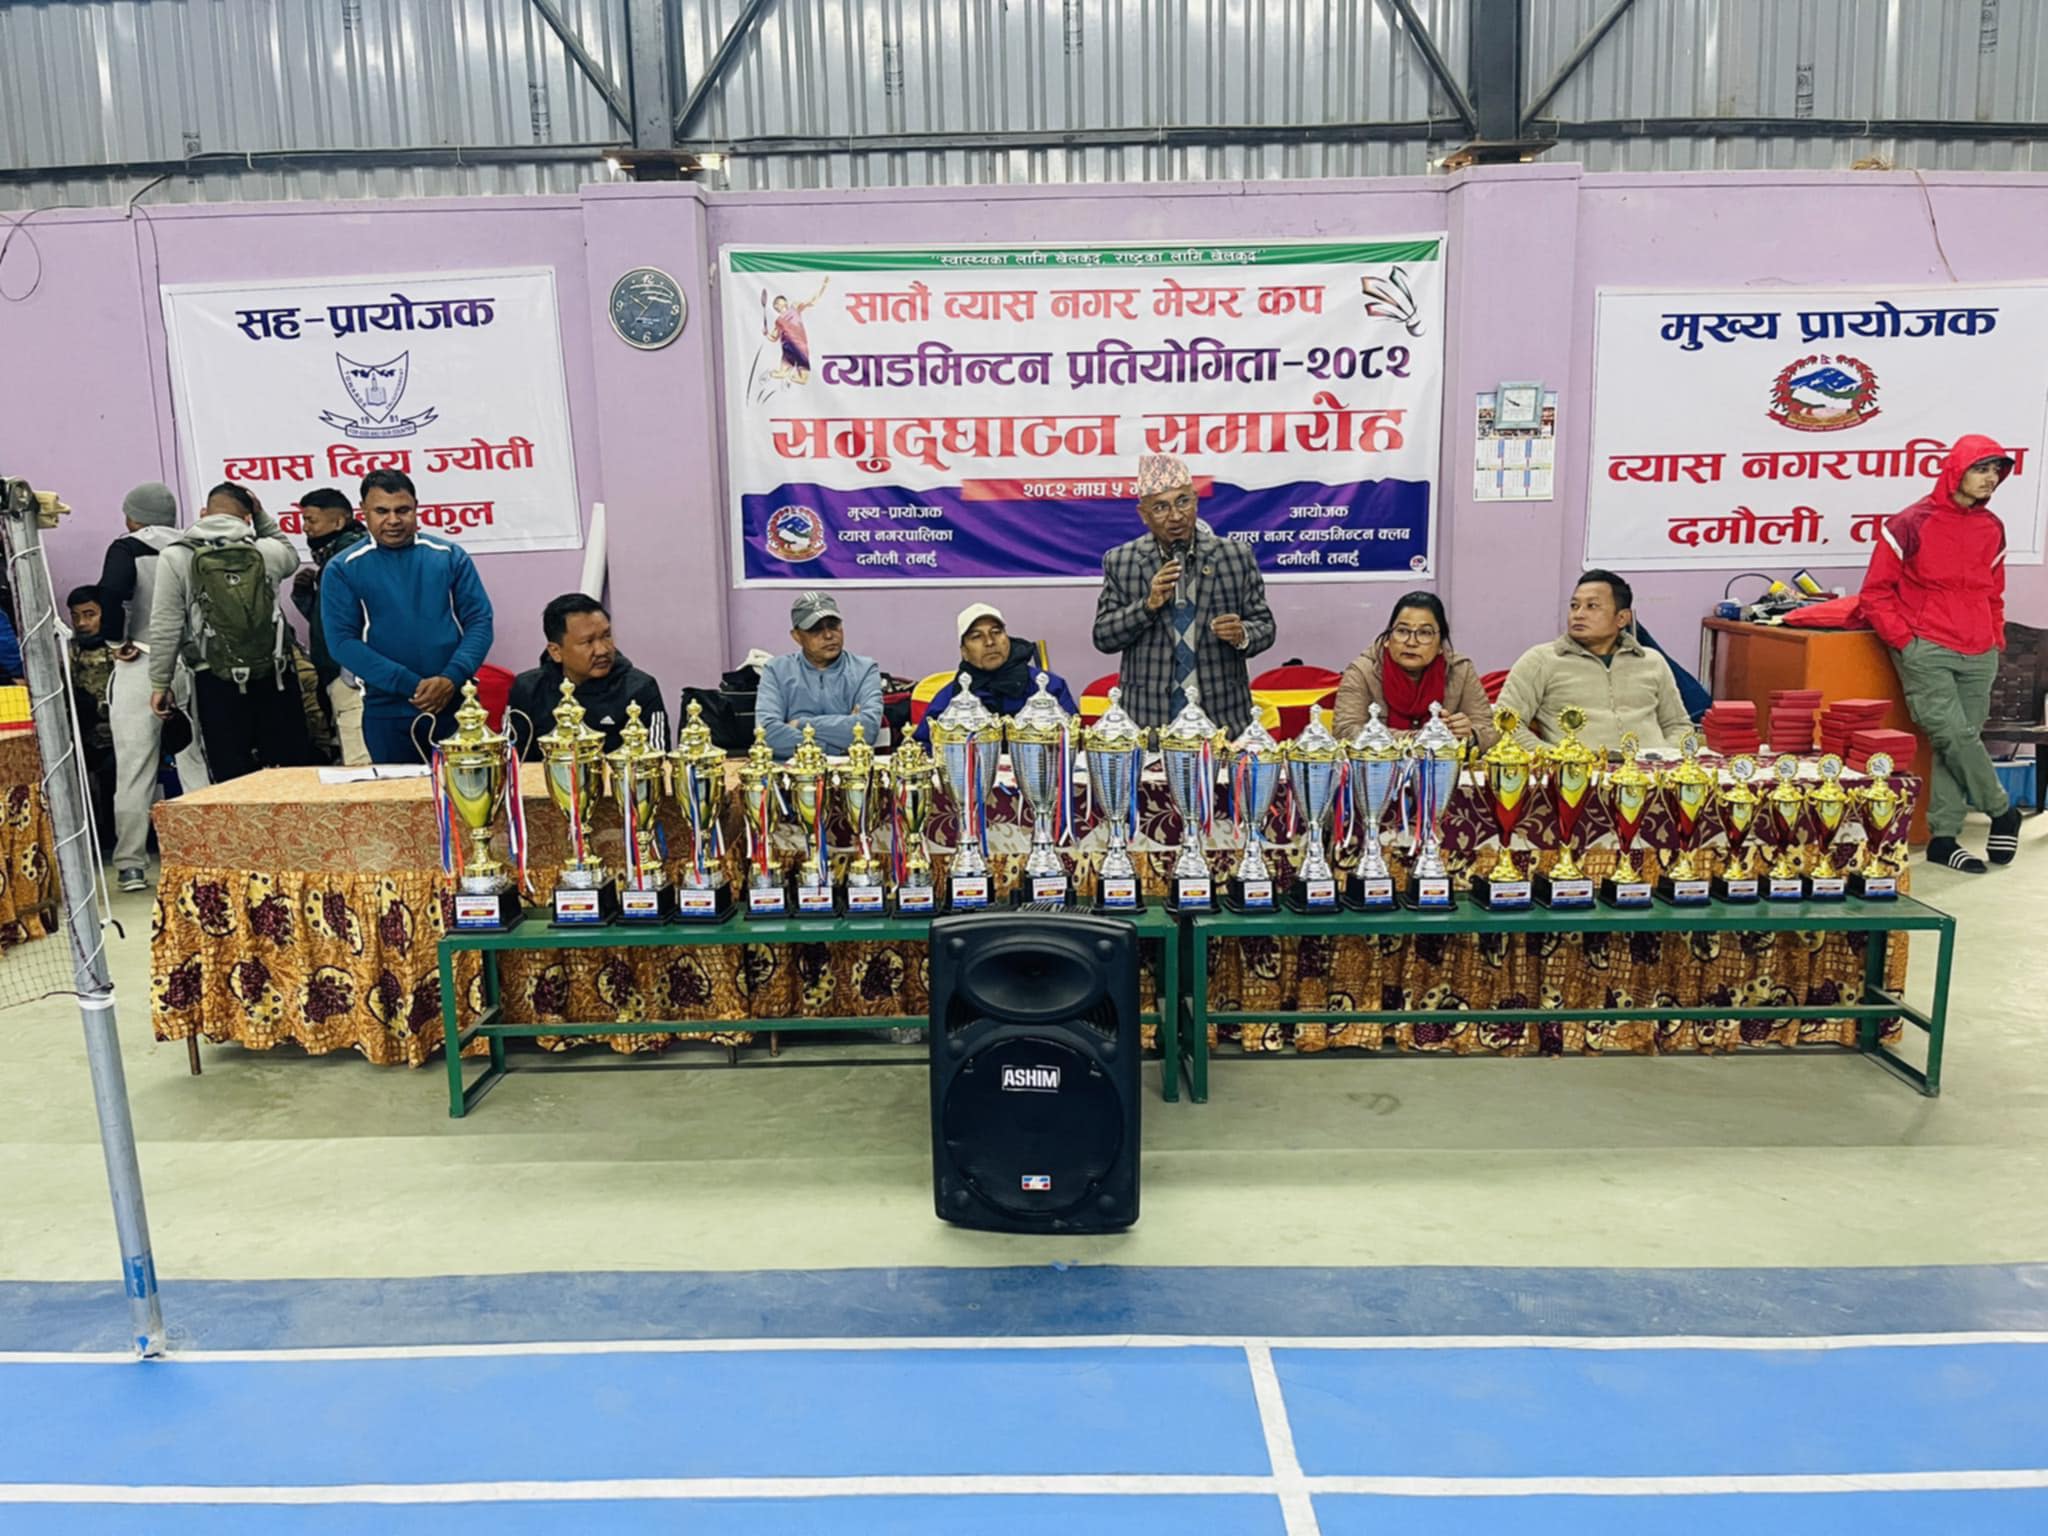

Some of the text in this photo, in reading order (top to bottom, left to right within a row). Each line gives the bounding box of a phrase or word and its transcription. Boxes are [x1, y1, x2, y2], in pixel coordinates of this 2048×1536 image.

[944, 290, 1037, 322] व्यास
[1050, 288, 1140, 320] नगर
[1153, 278, 1245, 318] मेयर
[1258, 285, 1326, 315] कप
[235, 293, 495, 340] सह-प्रायोजक
[1661, 301, 1999, 351] मुख्य प्रायोजक
[1144, 391, 1407, 456] समारोह
[224, 454, 314, 481] व्यास
[424, 436, 534, 474] ज्योती
[1608, 453, 1726, 483] व्यास
[1023, 482, 1067, 498] २०८२
[1073, 481, 1107, 497] माघ
[1111, 482, 1123, 498] ५
[1289, 503, 1349, 518] आयोजक
[838, 526, 953, 543] व्यास नगरपालिका
[1264, 529, 1296, 543] नगर
[1004, 1068, 1058, 1088] ASHIM
